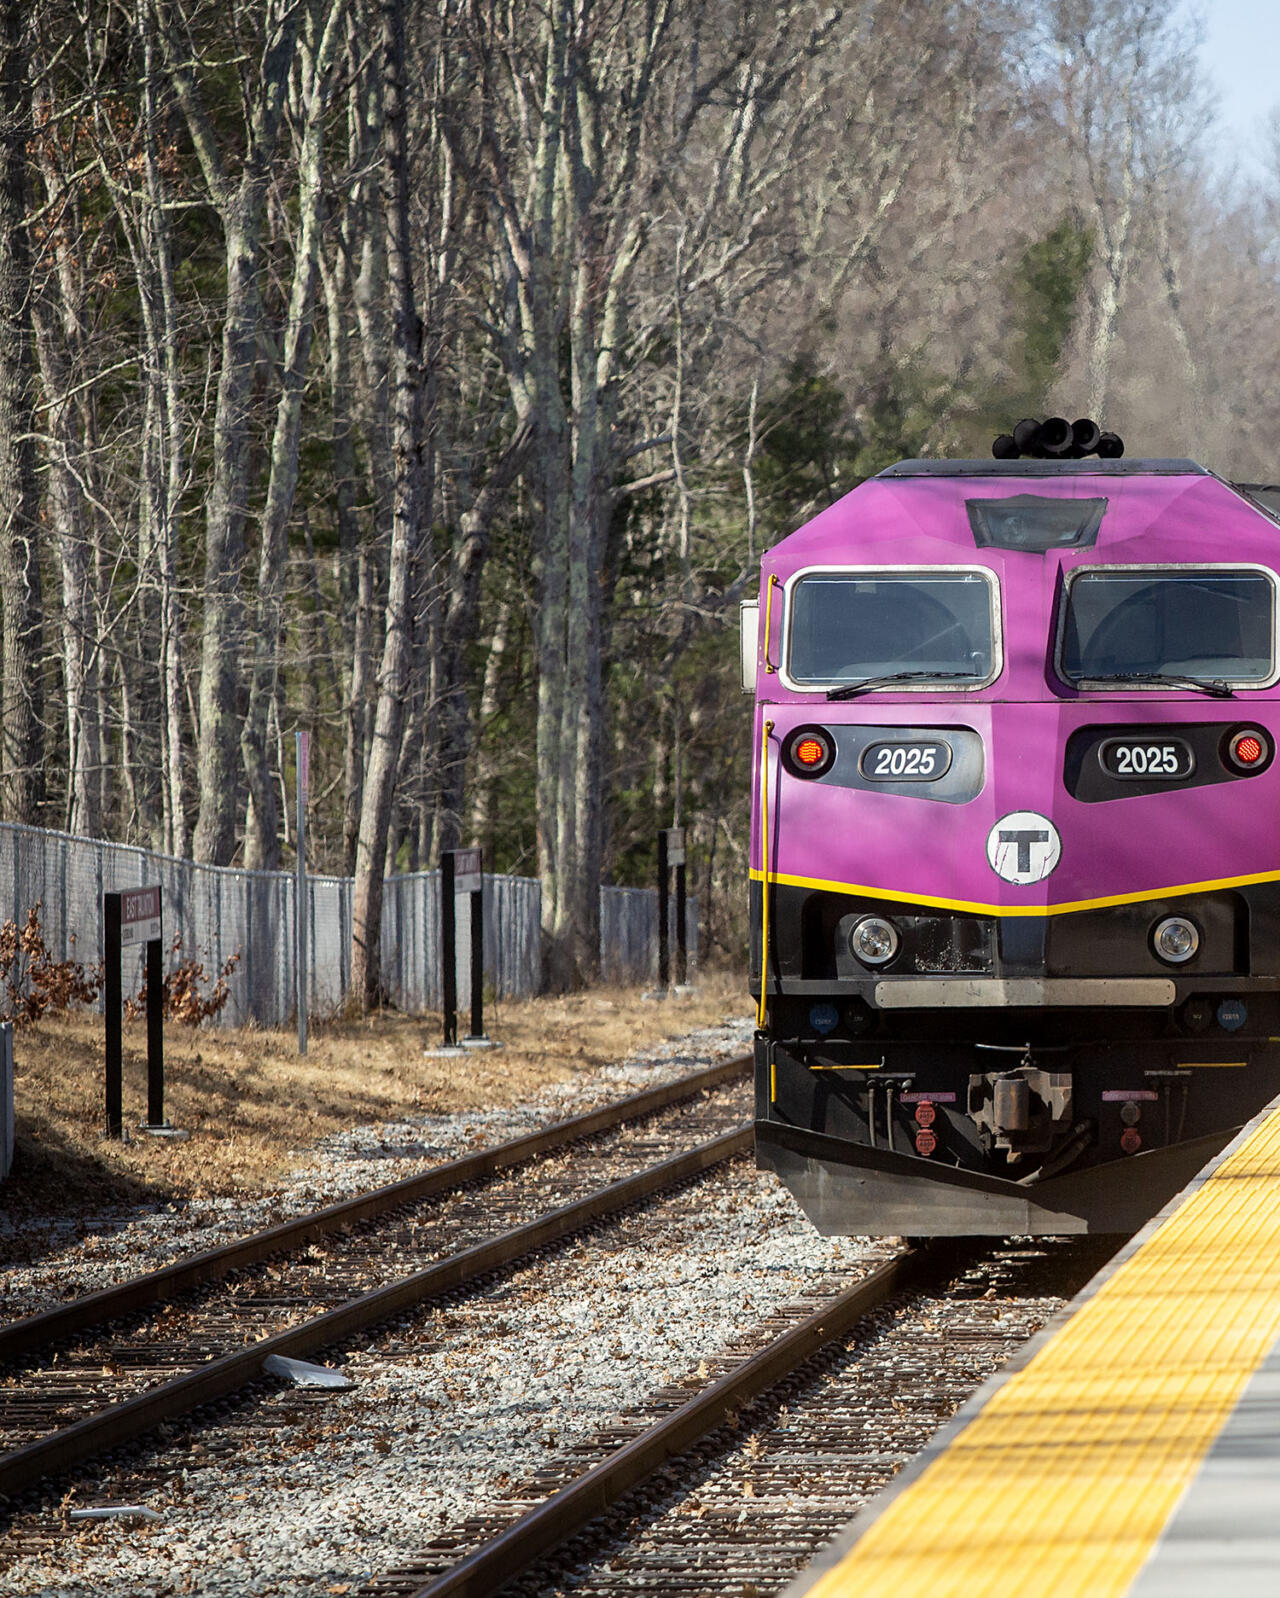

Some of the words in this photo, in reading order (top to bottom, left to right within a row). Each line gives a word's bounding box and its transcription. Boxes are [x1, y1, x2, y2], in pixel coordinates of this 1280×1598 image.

[874, 748, 937, 775] 2025
[1116, 746, 1179, 774] 2025
[999, 830, 1049, 873] T
